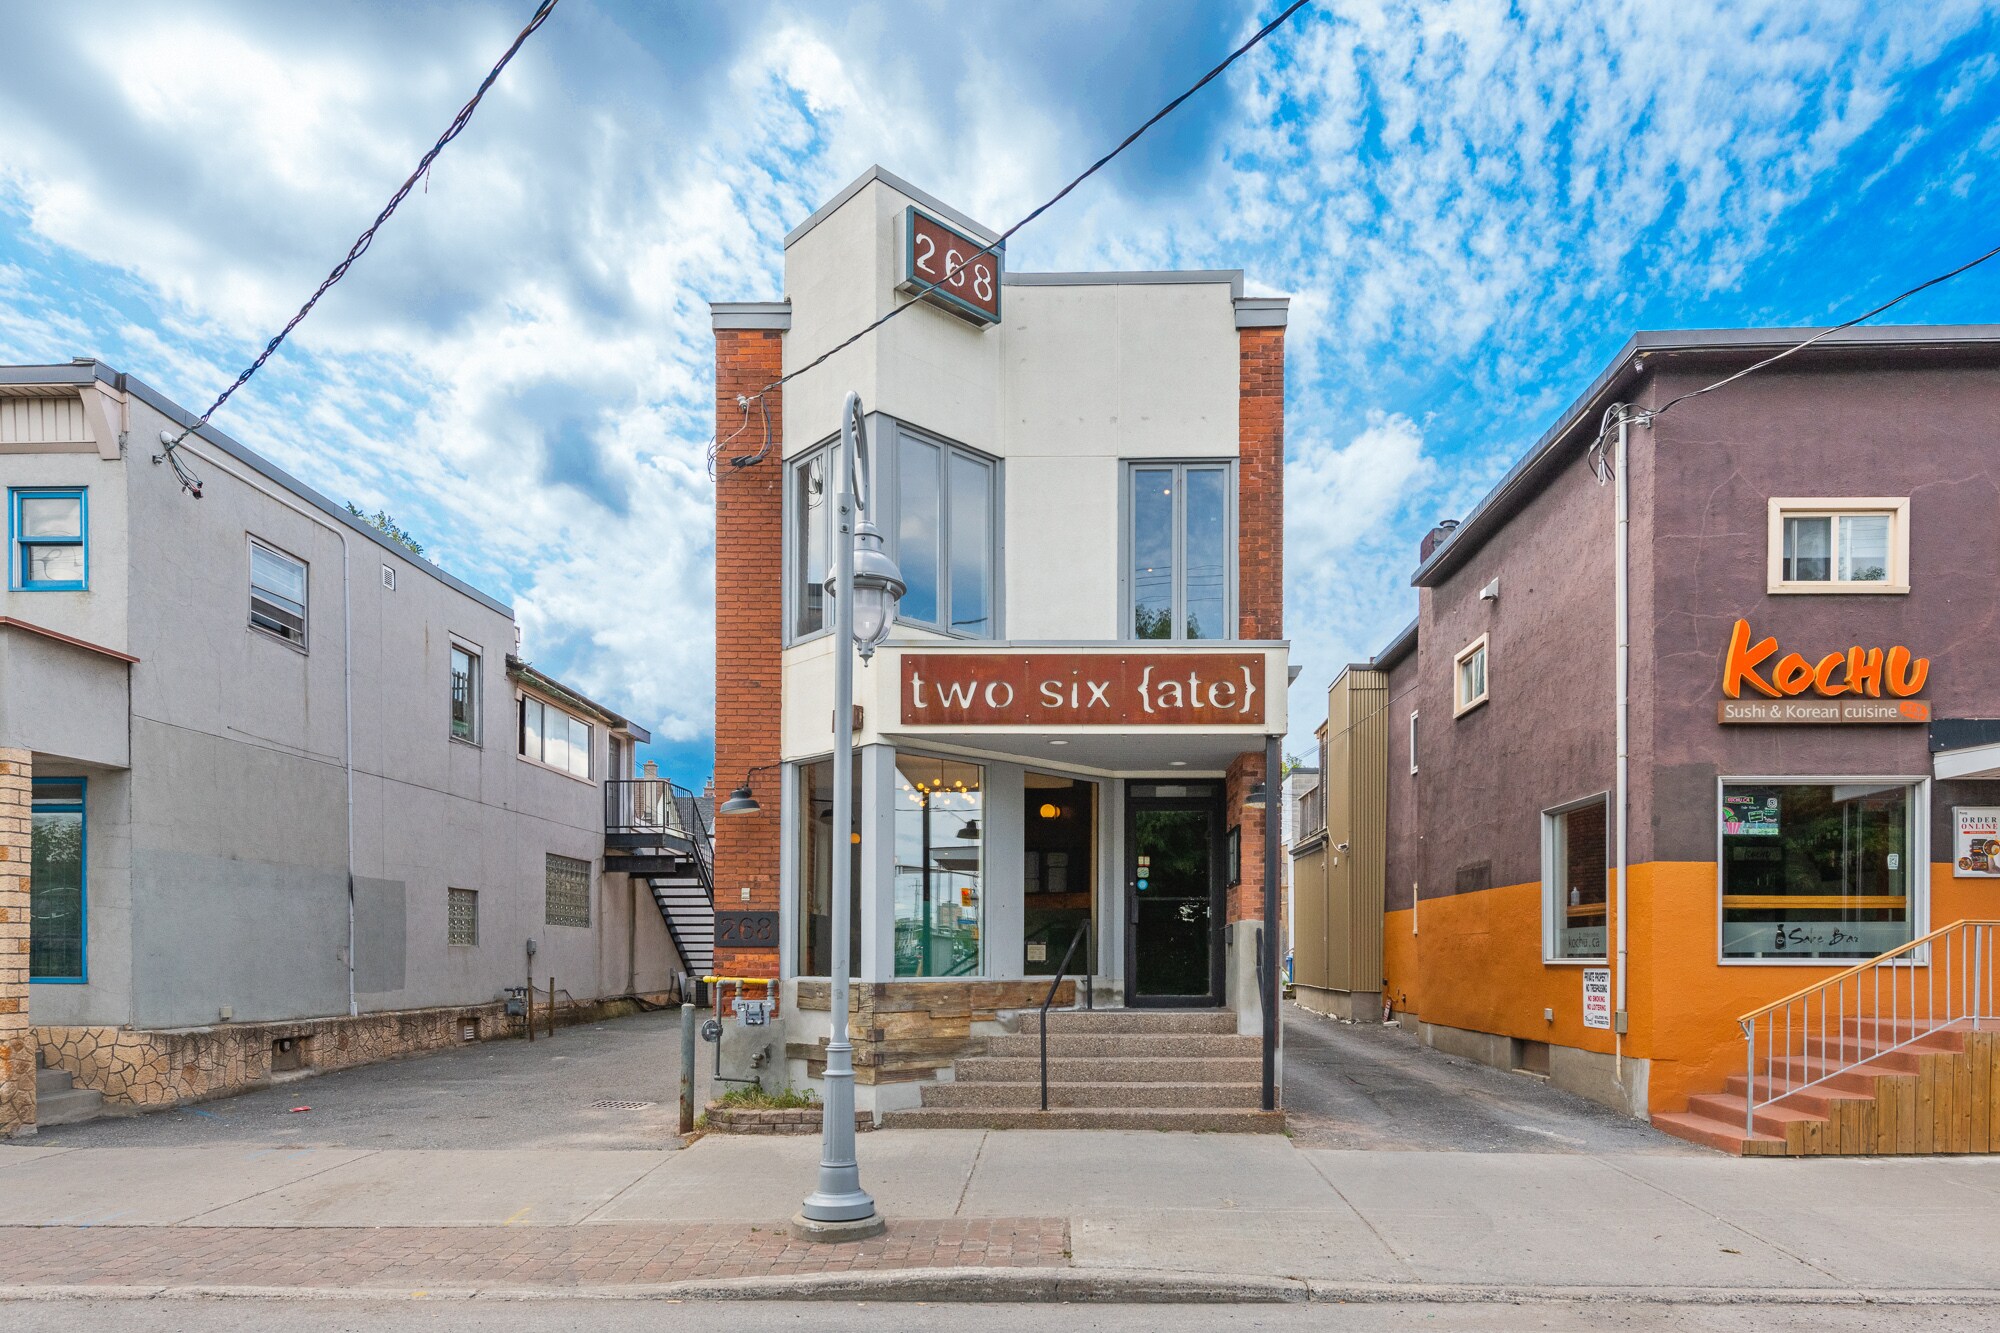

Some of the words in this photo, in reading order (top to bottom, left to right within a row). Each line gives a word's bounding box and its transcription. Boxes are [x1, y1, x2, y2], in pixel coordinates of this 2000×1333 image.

[916, 233, 993, 302] 268
[911, 671, 1014, 709] two
[1040, 669, 1111, 709] six
[1137, 665, 1257, 714] {ate}
[1725, 705, 1766, 718] Sushi
[1770, 705, 1782, 718] &
[1786, 705, 1839, 718] Korean
[1844, 705, 1897, 718] cuisine
[1962, 816, 1997, 824] ORDER
[721, 917, 771, 940] 268
[1829, 927, 1859, 946] Bar
